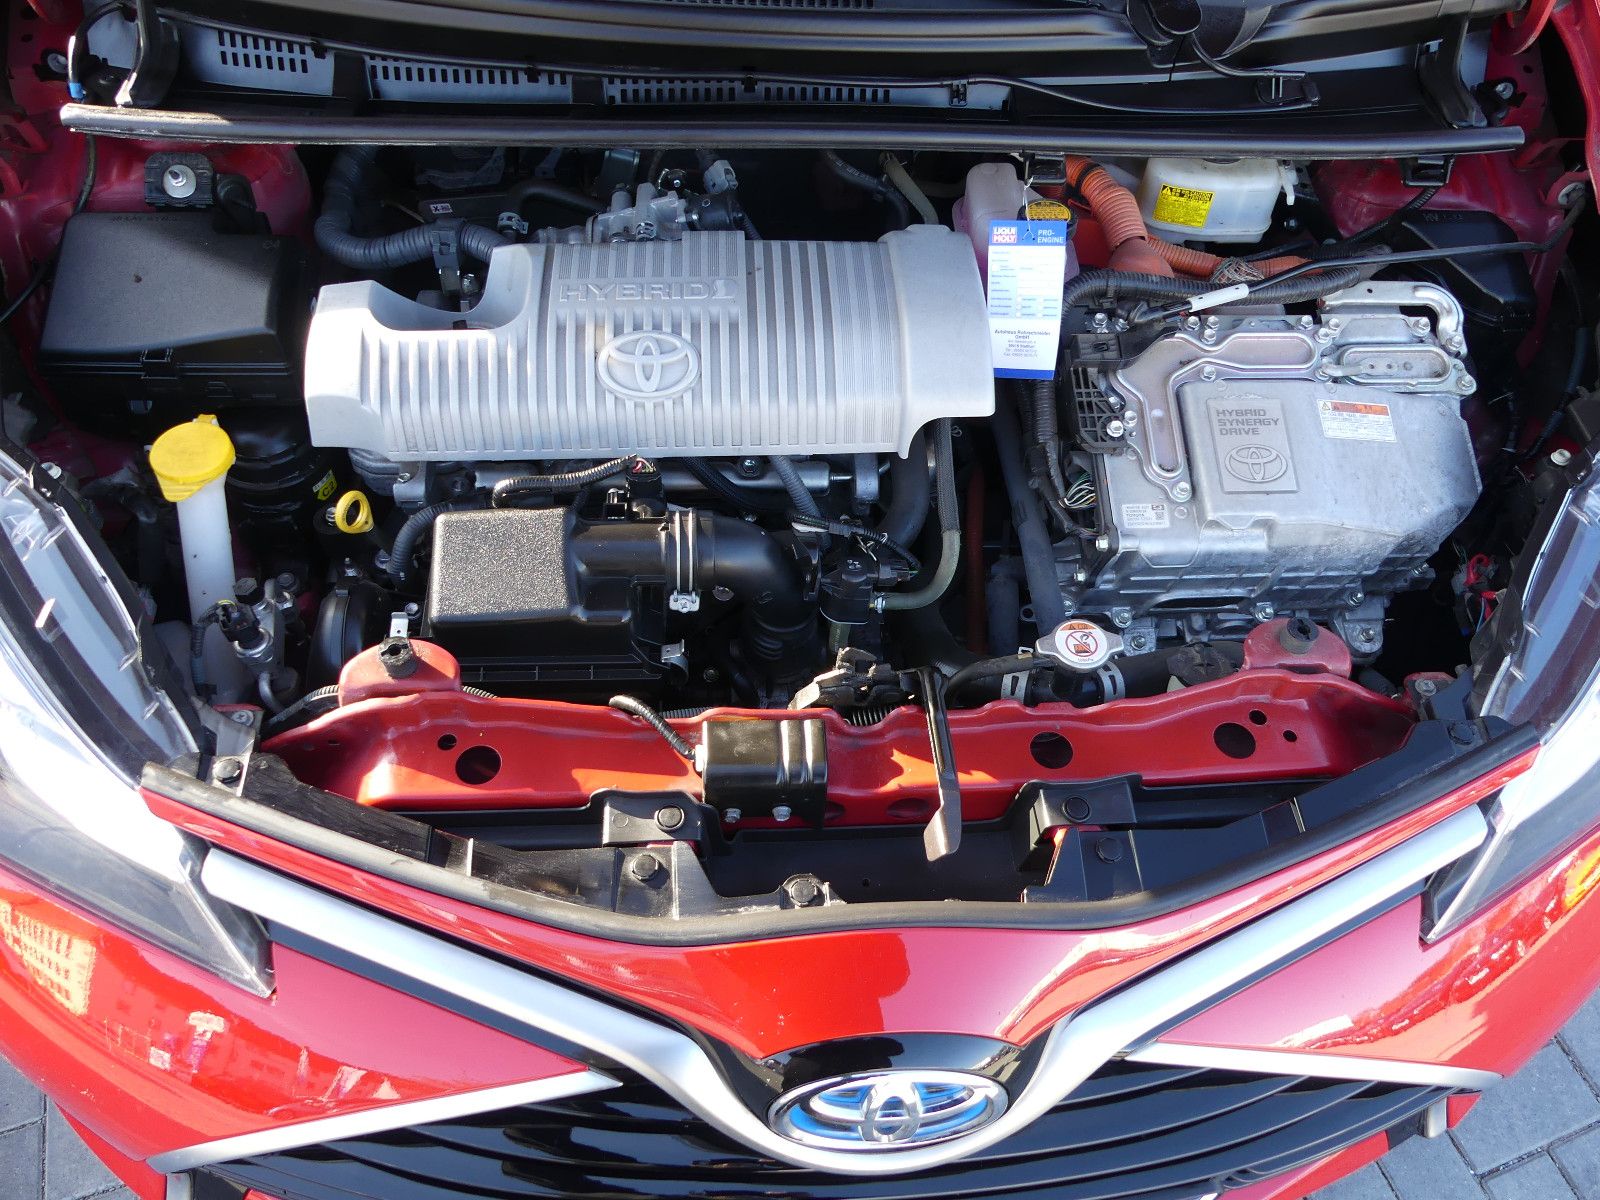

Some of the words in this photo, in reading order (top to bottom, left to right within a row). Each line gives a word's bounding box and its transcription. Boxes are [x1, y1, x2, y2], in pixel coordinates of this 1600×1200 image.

[993, 227, 1017, 235] LIQUI
[1038, 229, 1055, 237] PRO-
[992, 235, 1016, 243] MOLY
[1037, 236, 1064, 244] ENGINE
[559, 282, 710, 301] HYBRID
[1215, 408, 1267, 417] HYBRID
[1217, 418, 1280, 427] SYNERGY
[1219, 427, 1260, 436] DRIVE
